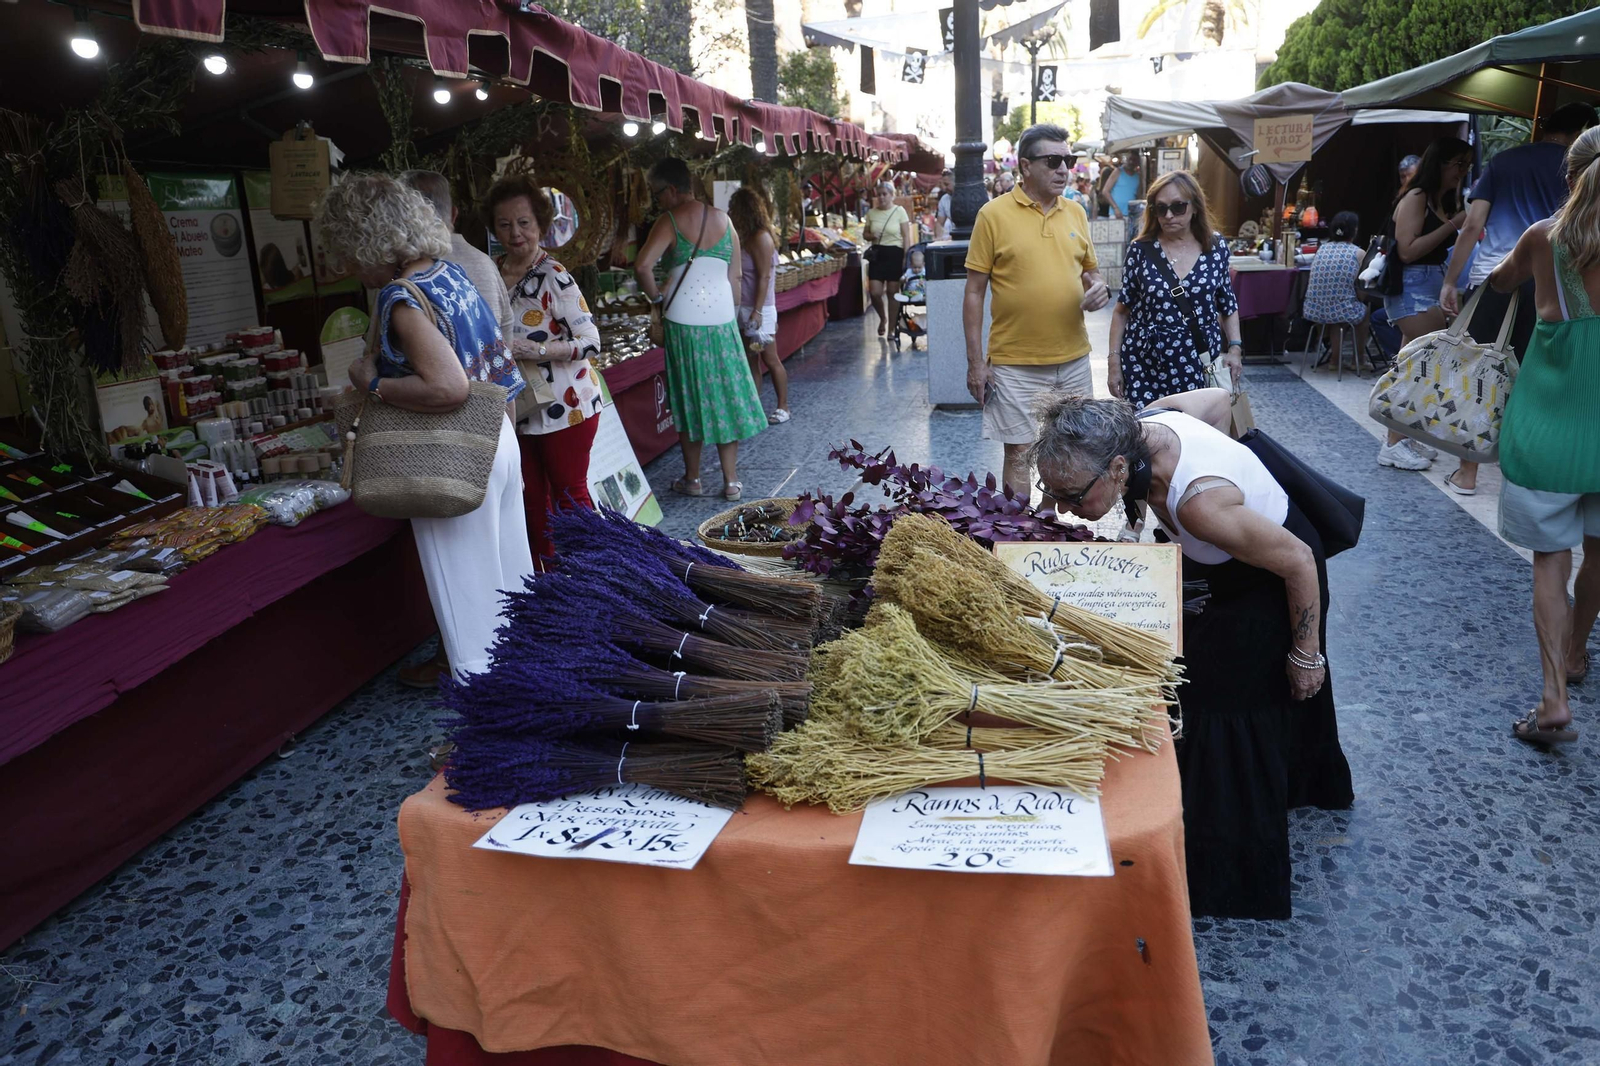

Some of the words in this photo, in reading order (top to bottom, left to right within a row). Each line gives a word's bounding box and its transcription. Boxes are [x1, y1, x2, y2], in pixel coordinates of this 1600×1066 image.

[1258, 122, 1312, 136] LECTURA
[1266, 135, 1303, 146] TAROT
[170, 216, 198, 228] Crema
[181, 230, 208, 242] Abuelo
[177, 246, 203, 257] Mateo
[1024, 547, 1073, 577] Ruda
[1074, 547, 1149, 578] Silvestre
[1063, 586, 1076, 598] las
[1078, 586, 1105, 598] malas
[1107, 588, 1158, 599] vibraciones
[892, 792, 981, 816] Ramos
[1001, 792, 1080, 815] Ruda
[560, 815, 584, 824] se
[635, 833, 689, 852] 15€
[959, 836, 973, 845] la
[978, 837, 1016, 845] buena
[944, 844, 961, 852] los
